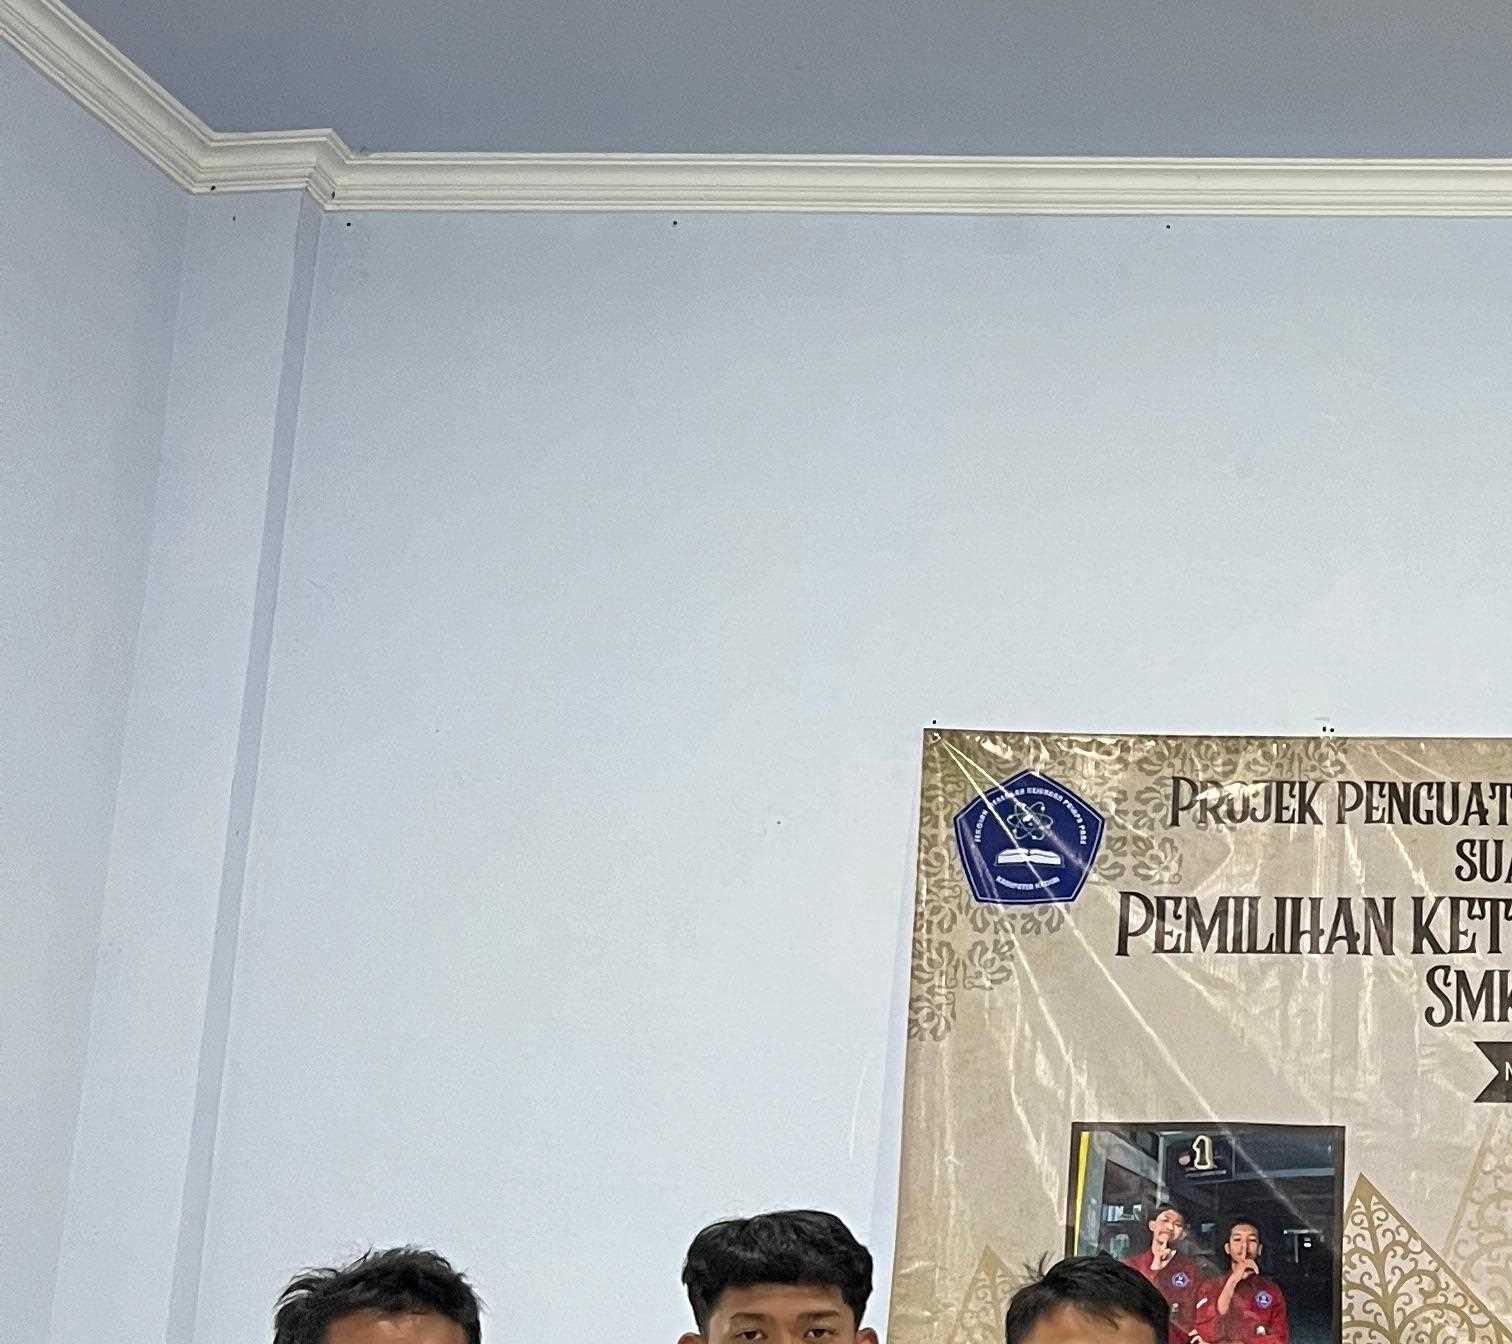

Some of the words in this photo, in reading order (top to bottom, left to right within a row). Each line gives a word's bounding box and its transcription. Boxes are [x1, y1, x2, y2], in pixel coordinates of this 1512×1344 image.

[1170, 776, 1323, 827] PROJEK
[1115, 891, 1396, 957] PEMILIHAN
[1192, 1135, 1214, 1170] 1
